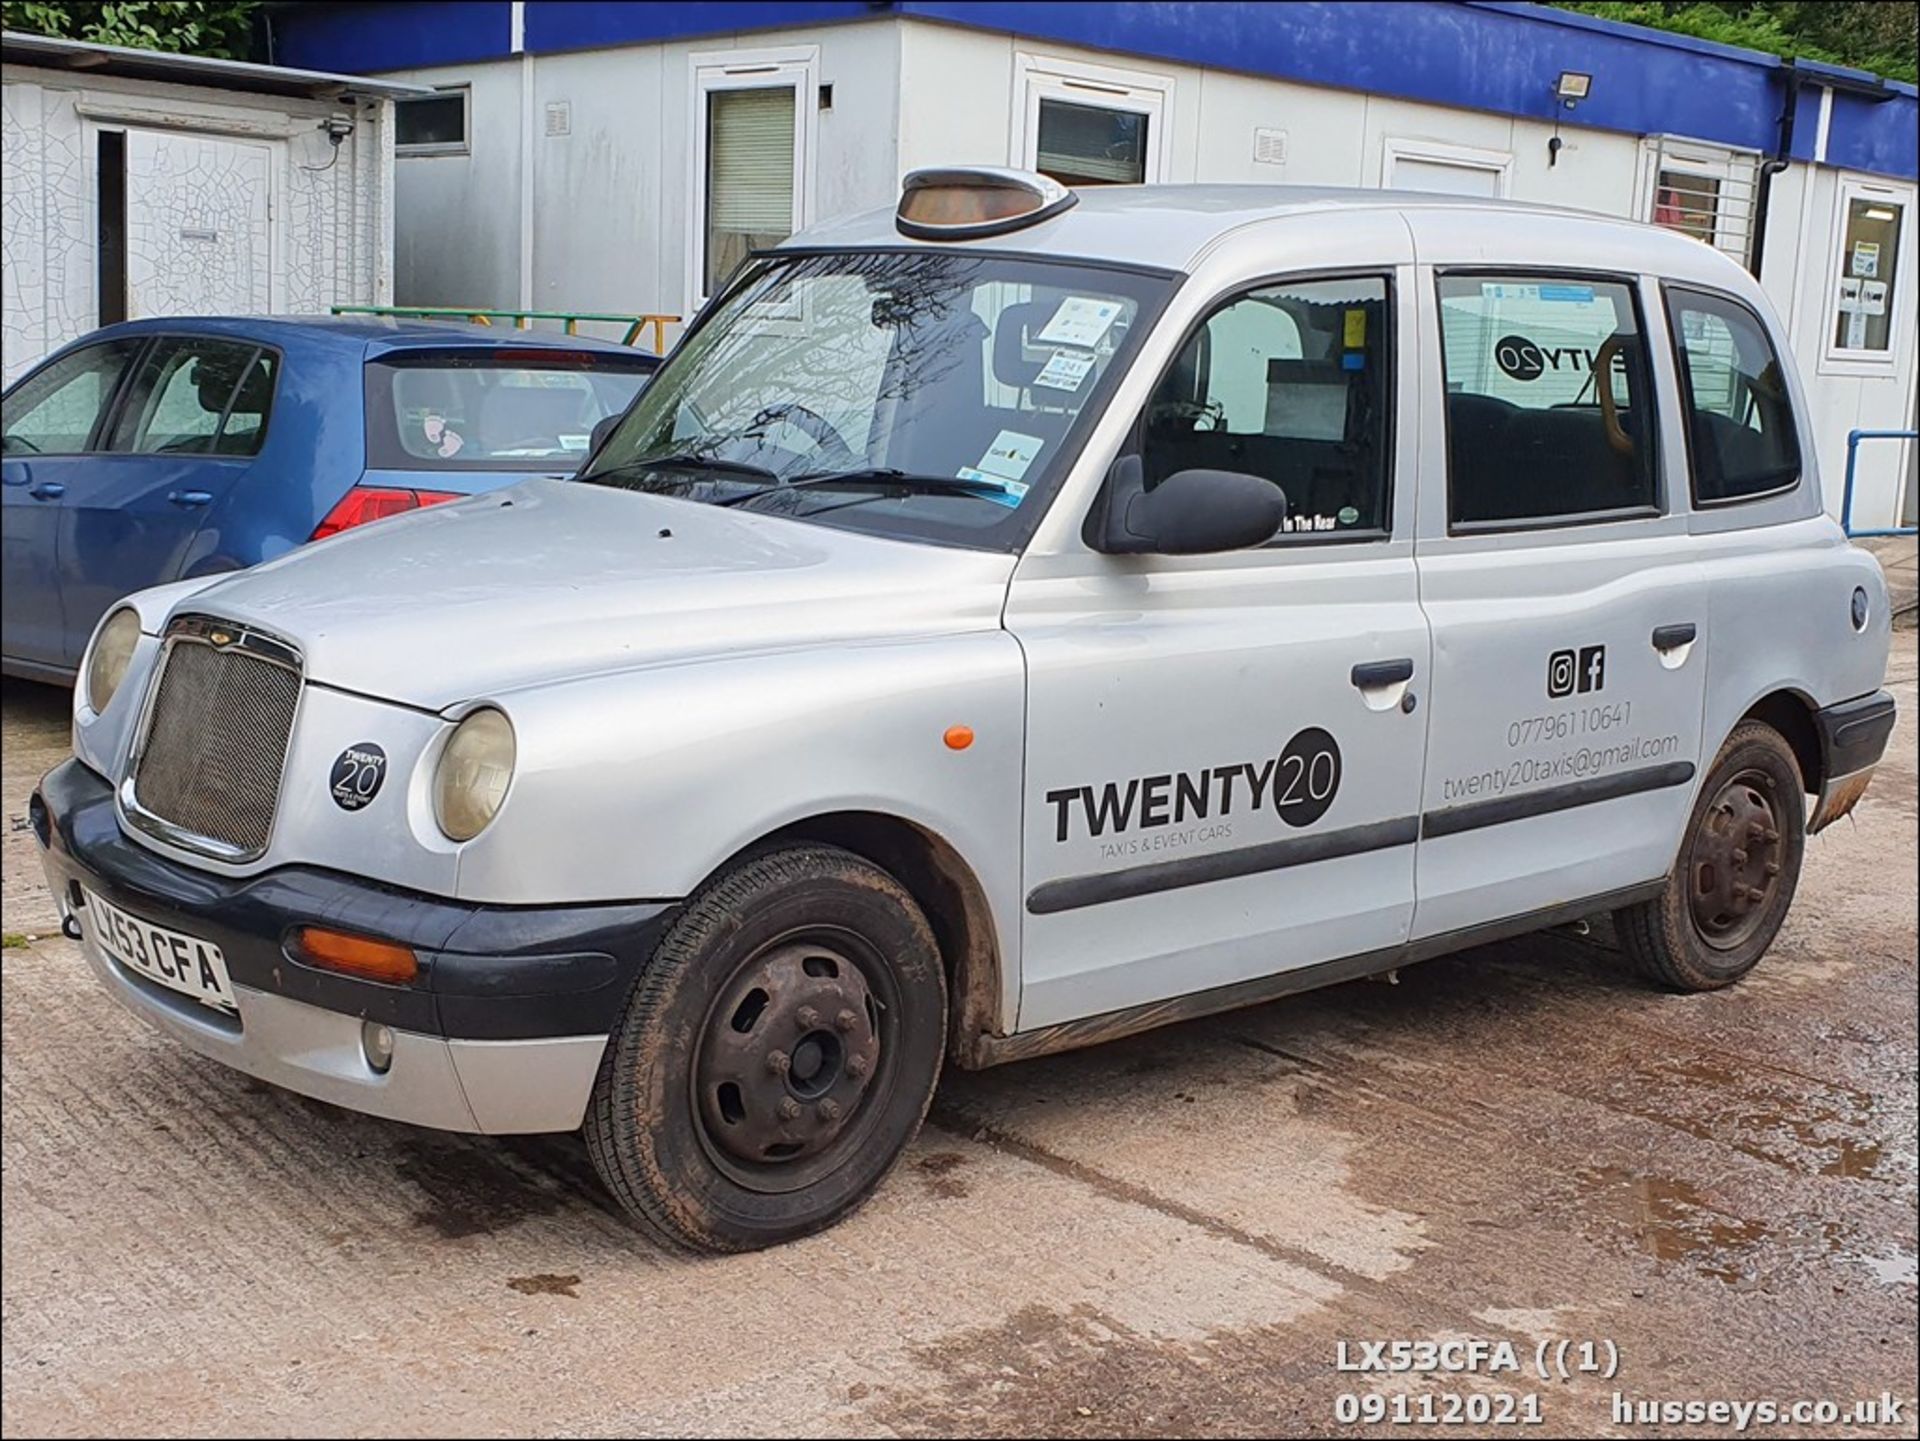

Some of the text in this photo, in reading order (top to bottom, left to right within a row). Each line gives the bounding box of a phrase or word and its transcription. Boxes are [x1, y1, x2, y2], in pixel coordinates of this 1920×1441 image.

[1295, 515, 1312, 532] The
[1508, 701, 1631, 747] 07796110641
[336, 760, 377, 794] 20
[1444, 735, 1679, 800] twenty20taxis@gmail.com
[1141, 838, 1151, 852] &
[1154, 829, 1195, 851] EVENT
[1198, 823, 1233, 843] CARS
